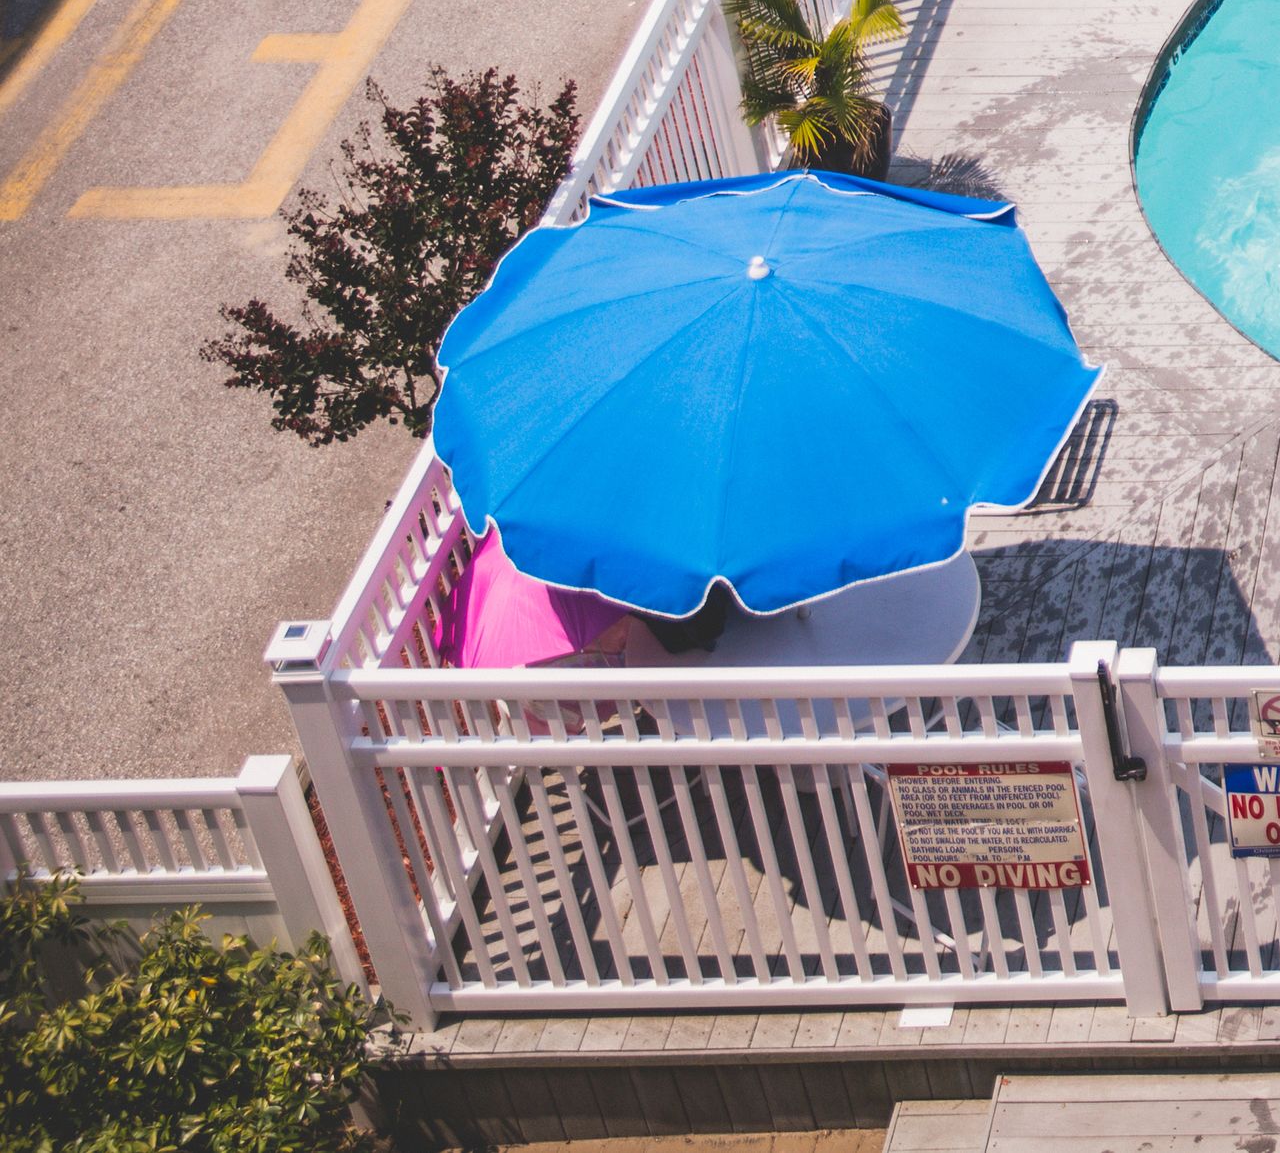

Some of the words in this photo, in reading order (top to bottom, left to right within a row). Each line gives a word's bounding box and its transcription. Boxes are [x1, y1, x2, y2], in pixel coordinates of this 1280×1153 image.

[917, 765, 968, 776] POOL
[978, 762, 1040, 775] RULES
[897, 777, 929, 785] SHOWER
[932, 777, 961, 785] BEFORE
[899, 786, 910, 794] NO
[912, 786, 936, 794] GLASS
[938, 786, 949, 794] OR
[951, 786, 984, 794] ANIMALS
[987, 785, 995, 793] IN
[997, 785, 1011, 793] THE
[1014, 784, 1044, 792] FENCED
[1046, 783, 1066, 791] POOL
[922, 794, 935, 802] (OR
[950, 793, 967, 801] FEET
[970, 793, 991, 801] FROM
[994, 792, 1034, 801] UNFENCED
[951, 802, 995, 810] BEVERAGES
[1029, 801, 1040, 809] OR
[1232, 794, 1265, 819] NO
[904, 810, 924, 818] POOL
[927, 810, 942, 818] WET
[934, 827, 946, 835] USE
[948, 827, 960, 835] THE
[962, 827, 978, 835] POOL
[988, 827, 1001, 835] YOU
[1003, 827, 1015, 835] ARE
[1017, 827, 1026, 835] ILL
[1027, 826, 1044, 834] WITH
[936, 837, 966, 845] SWALLOW
[968, 837, 980, 845] THE
[1014, 836, 1020, 844] IS
[916, 864, 961, 887] NO
[974, 862, 1082, 887] DIVING
